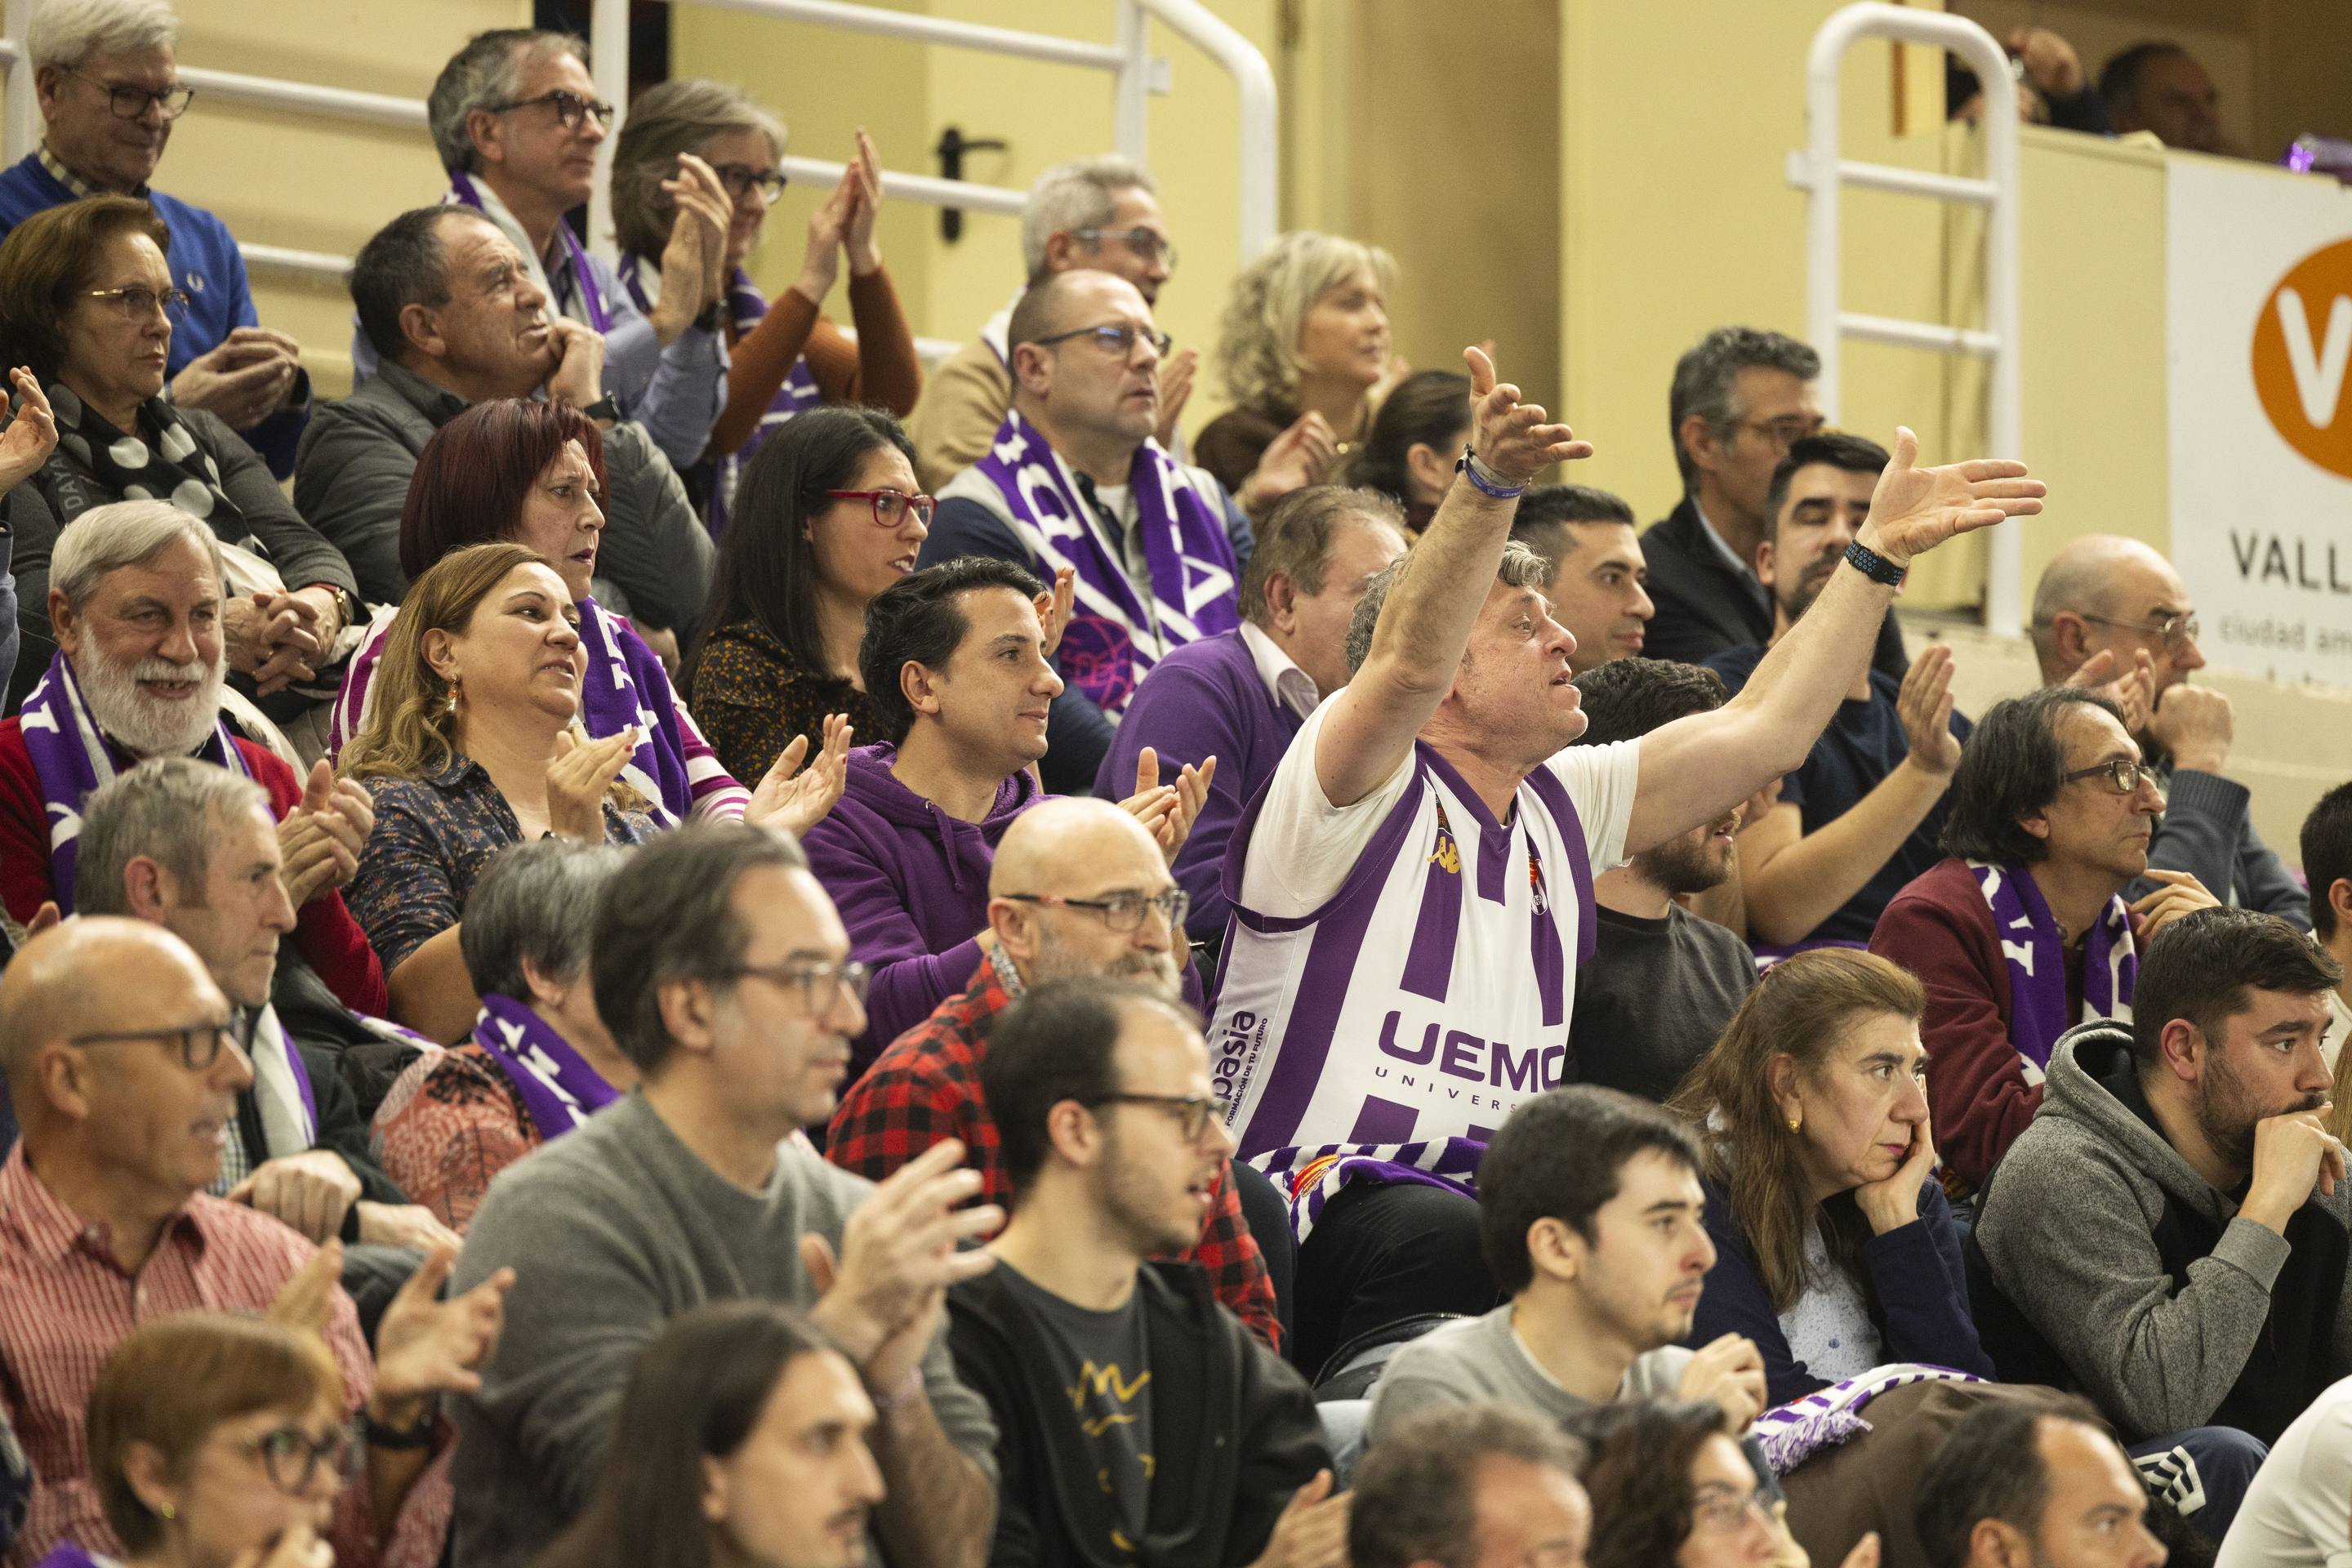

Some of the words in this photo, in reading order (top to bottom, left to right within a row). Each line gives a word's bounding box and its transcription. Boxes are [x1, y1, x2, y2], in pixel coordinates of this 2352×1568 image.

[2230, 528, 2351, 595] VALL
[1226, 1078, 1248, 1126] FORMACIÓN
[1243, 1065, 1253, 1079] DE
[1248, 1052, 1256, 1064] TU
[1253, 1018, 1267, 1053] FUTURO
